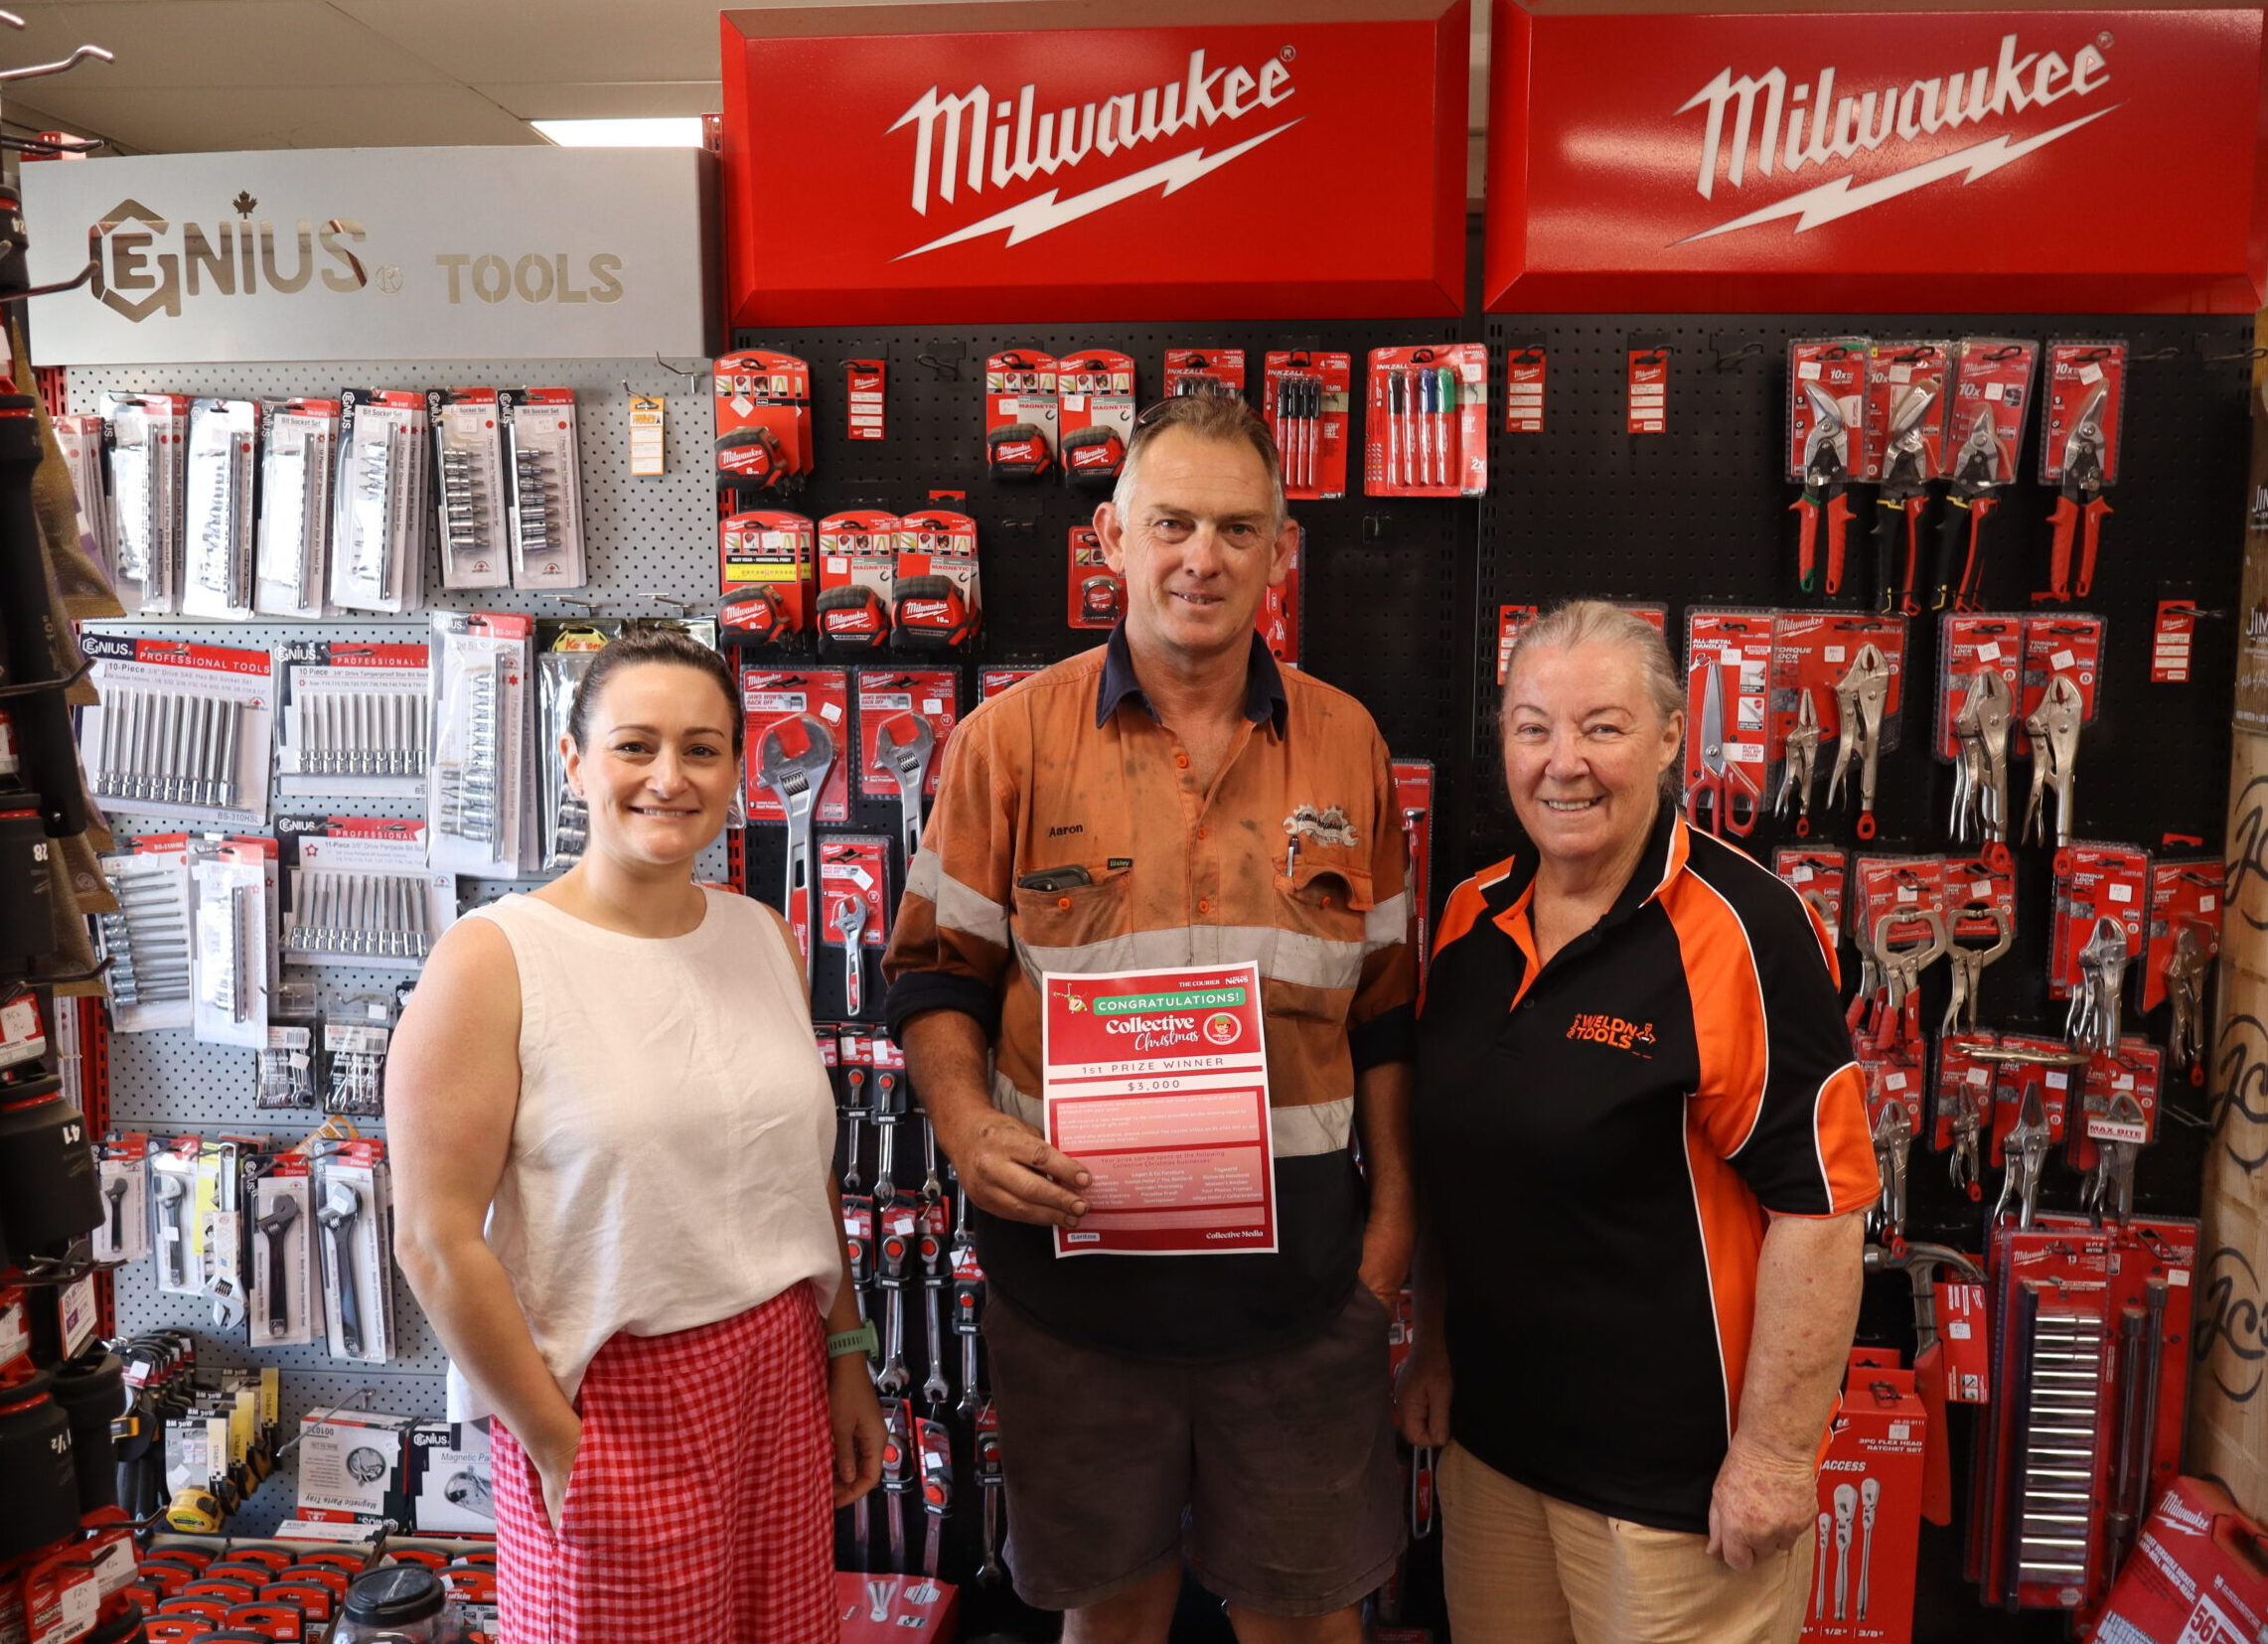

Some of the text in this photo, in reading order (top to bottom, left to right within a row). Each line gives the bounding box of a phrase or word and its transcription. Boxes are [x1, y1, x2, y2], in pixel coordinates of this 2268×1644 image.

[1673, 33, 2112, 200] Milwaukee
[884, 49, 1295, 217] Milwaukee
[435, 253, 624, 305] TOOLS
[722, 449, 763, 464] Milwaukee
[726, 604, 766, 620] Milwaukee
[906, 601, 948, 613] Milwaukee
[828, 612, 868, 626] Milwaukee
[1777, 618, 1824, 633] Milwaukee
[108, 664, 145, 673] 10-Piece
[139, 652, 227, 669] PROFESSIONAL
[232, 662, 270, 674] TOOLS
[749, 673, 782, 685] Milwaukee
[862, 673, 893, 685] Milwaukee
[336, 830, 413, 840] PROFESSIONAL
[1049, 824, 1083, 837] Aaron
[1098, 992, 1240, 1011] CONGRATULATIONS!
[1106, 1014, 1195, 1034] Collective
[1134, 1030, 1199, 1052] Christmas
[1577, 1027, 1633, 1049] TOOLS
[1083, 1057, 1225, 1075] 1st PRIZE WINNER
[1128, 1080, 1180, 1092] $3,000
[2090, 1124, 2142, 1138] MAX BITE
[442, 1453, 477, 1463] Magnetic
[1822, 1460, 1866, 1471] ACCESS
[305, 1494, 378, 1510] Magnetic Parts Tray
[2160, 1491, 2210, 1530] Milwaukee
